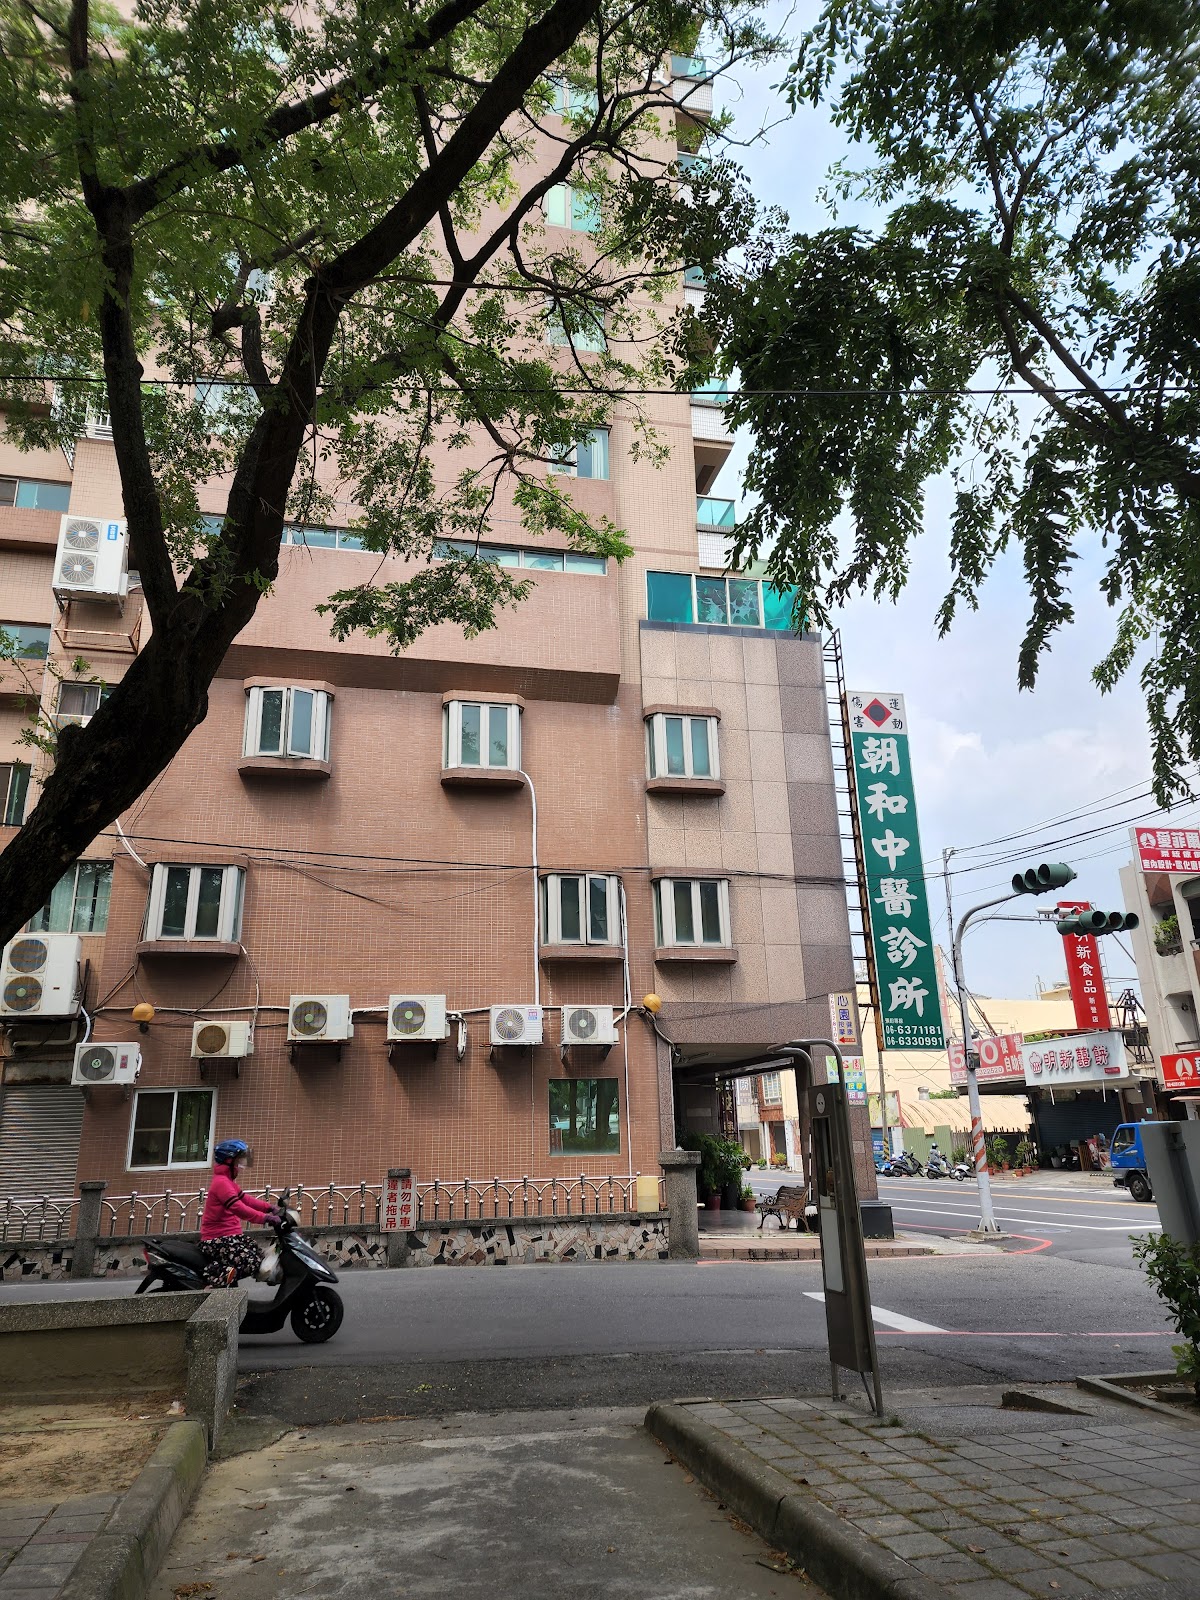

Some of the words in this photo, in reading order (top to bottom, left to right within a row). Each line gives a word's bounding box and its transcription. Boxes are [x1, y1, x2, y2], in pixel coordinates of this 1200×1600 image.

[851, 696, 864, 728] 傷害
[889, 698, 903, 730] 運動
[859, 736, 930, 1018] 朝和中醫診所
[885, 1025, 941, 1035] 06-6371181
[886, 1036, 943, 1046] 06-6330991
[386, 1180, 398, 1228] 違者拖吊
[400, 1179, 412, 1228] 請勿停車
